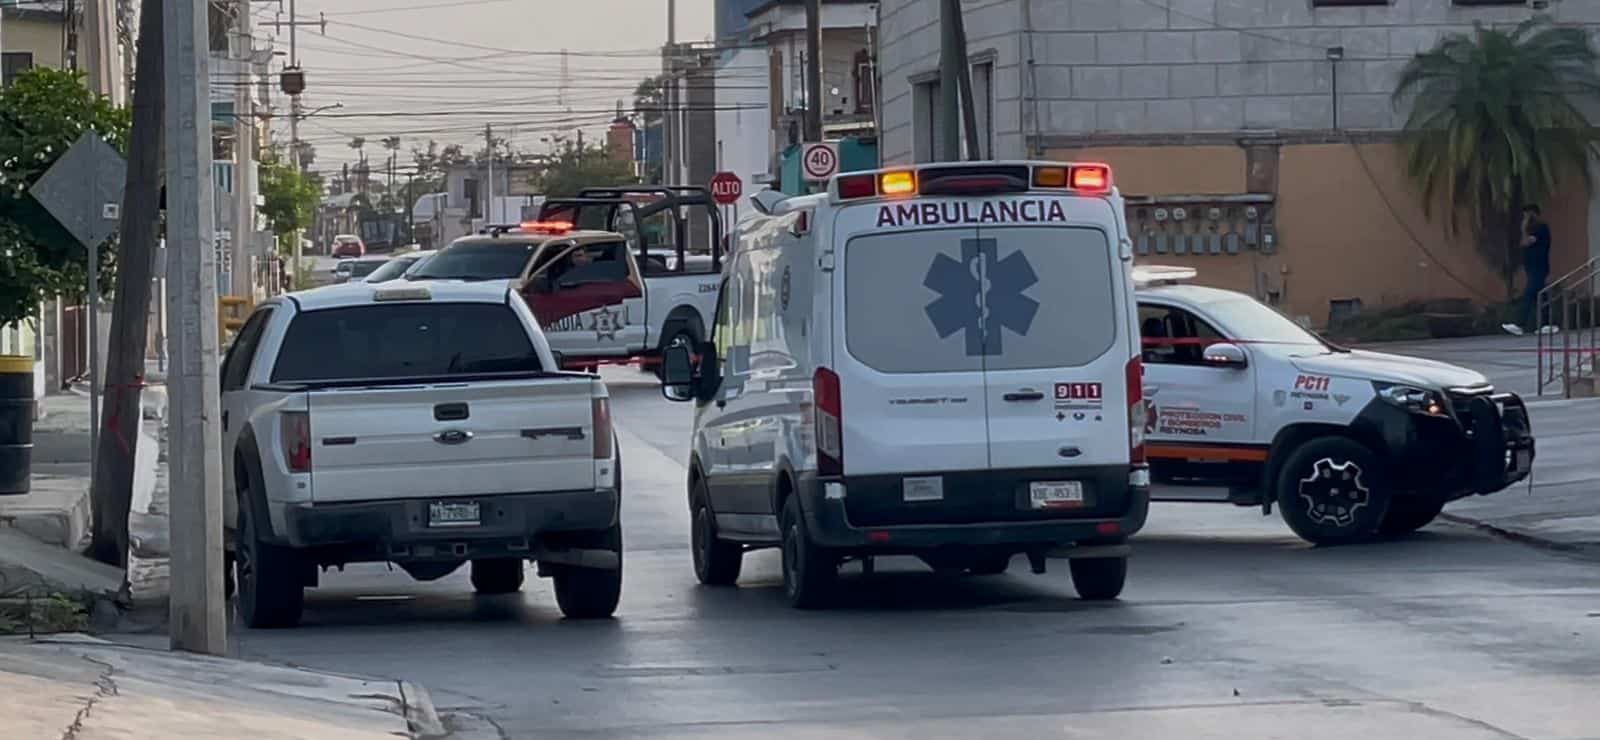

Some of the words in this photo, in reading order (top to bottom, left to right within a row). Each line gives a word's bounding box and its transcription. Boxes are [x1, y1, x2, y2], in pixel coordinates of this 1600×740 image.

[811, 151, 829, 166] 40
[712, 182, 740, 195] ALTO
[876, 200, 1066, 227] AMBULANCIA
[1294, 375, 1330, 391] PC11
[1056, 384, 1099, 398] 911
